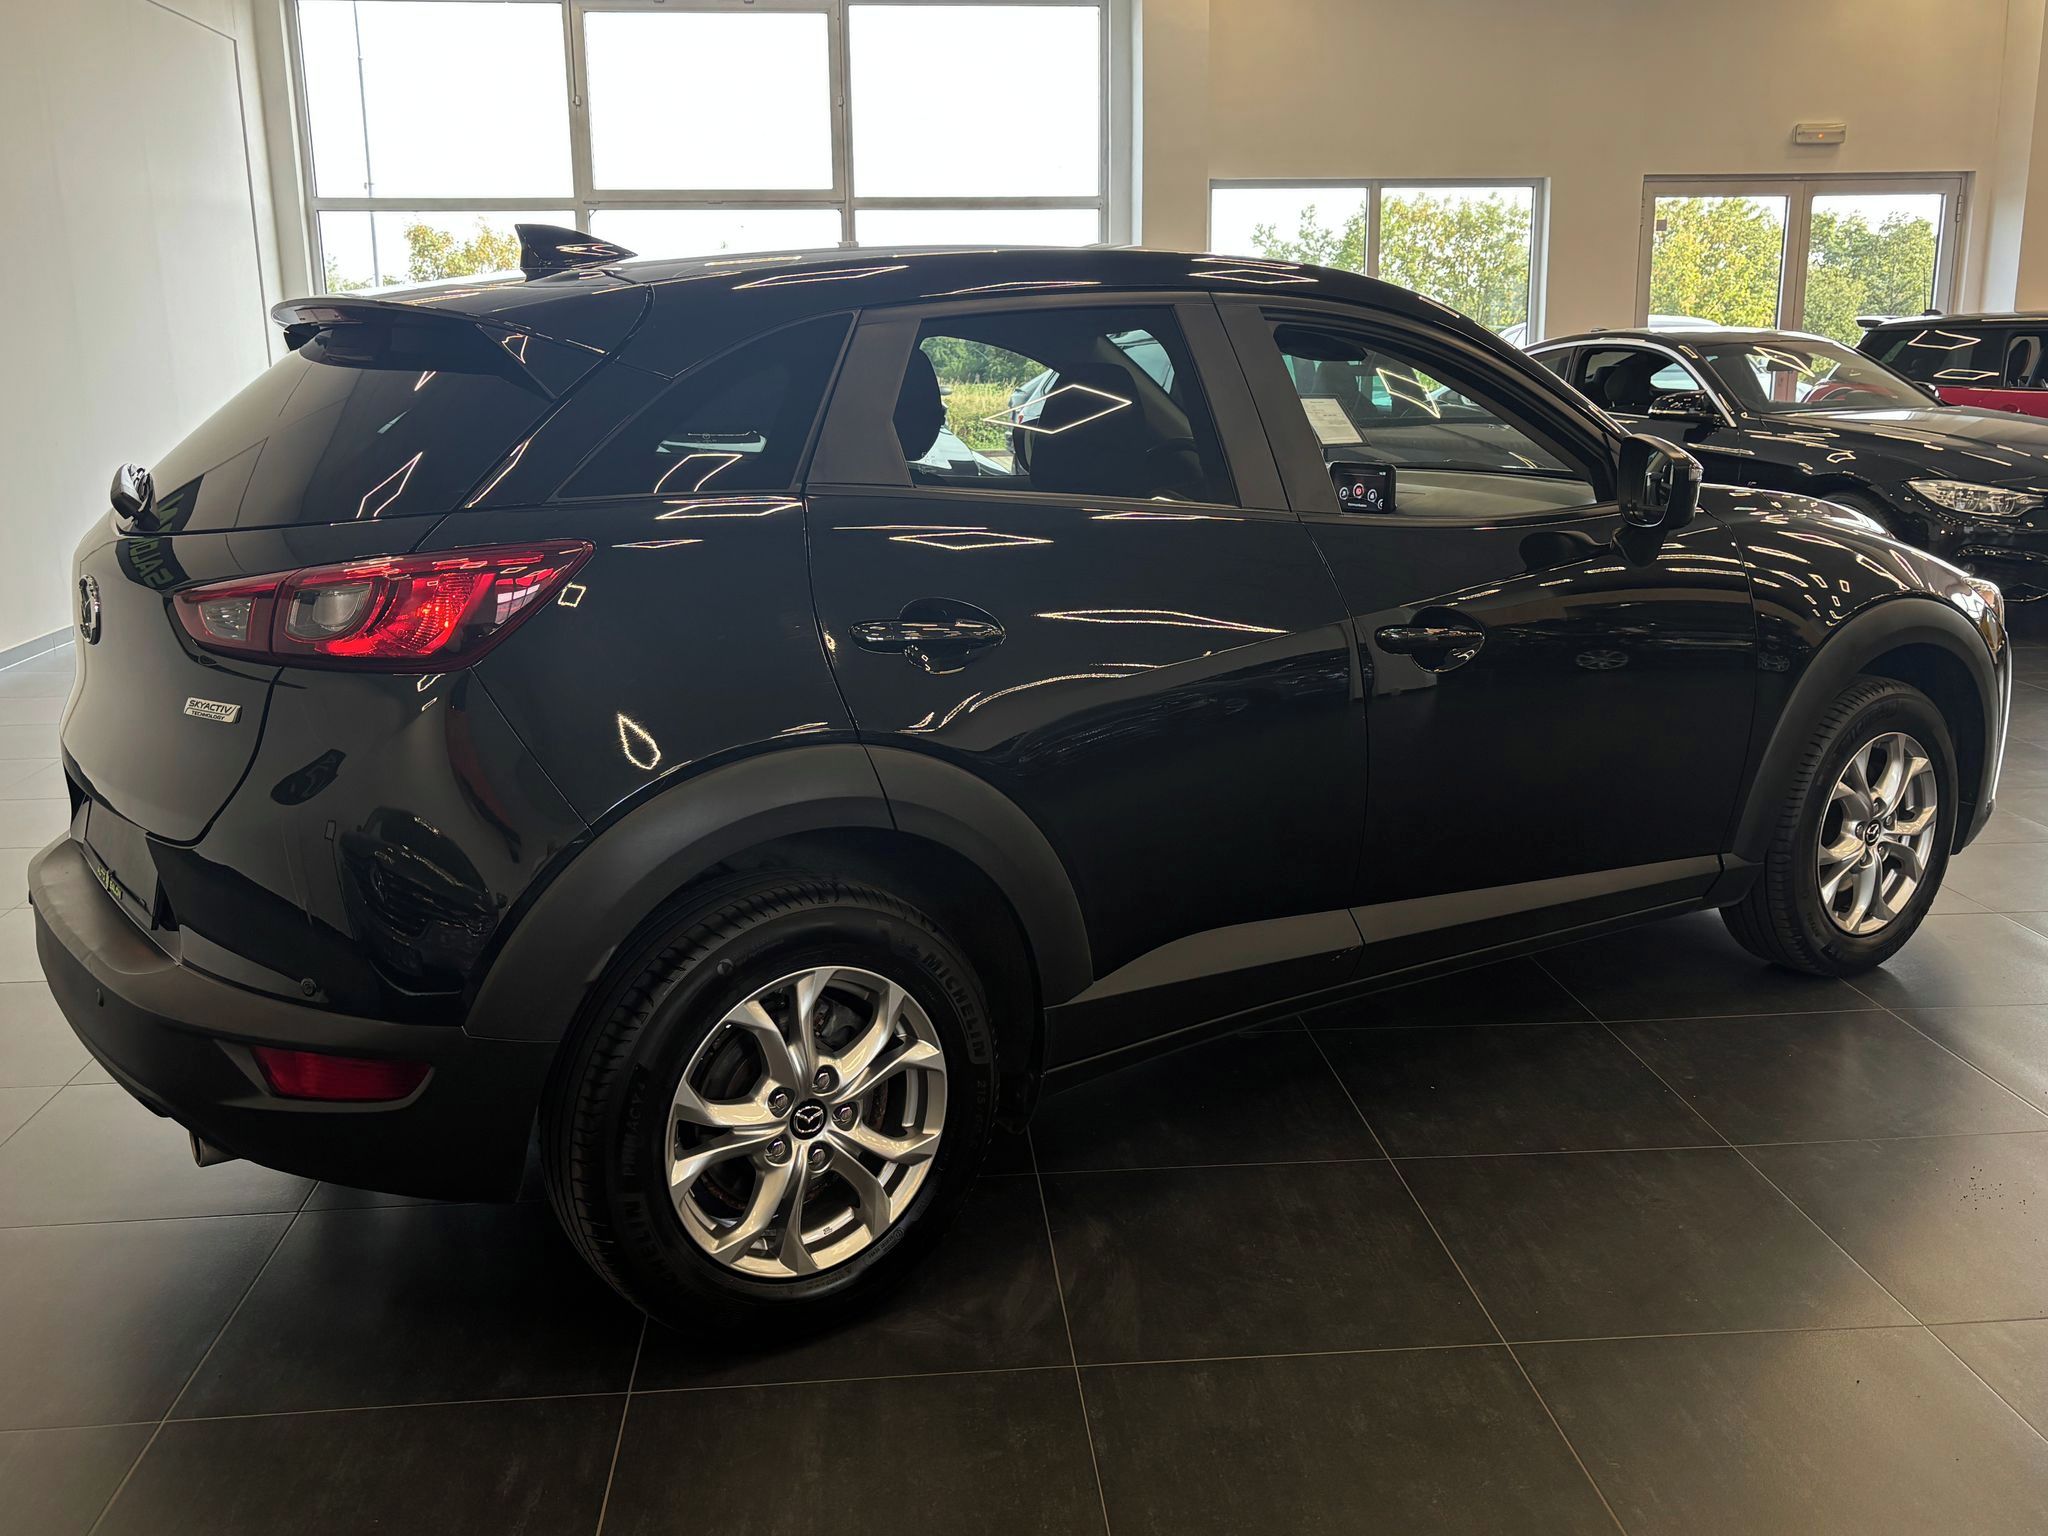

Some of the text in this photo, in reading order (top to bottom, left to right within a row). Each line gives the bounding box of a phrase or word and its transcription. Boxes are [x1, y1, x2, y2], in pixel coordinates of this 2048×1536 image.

[189, 699, 232, 714] SKYACTIV
[191, 711, 225, 720] TECHNOLOGY
[922, 951, 986, 1058] MICHELIN
